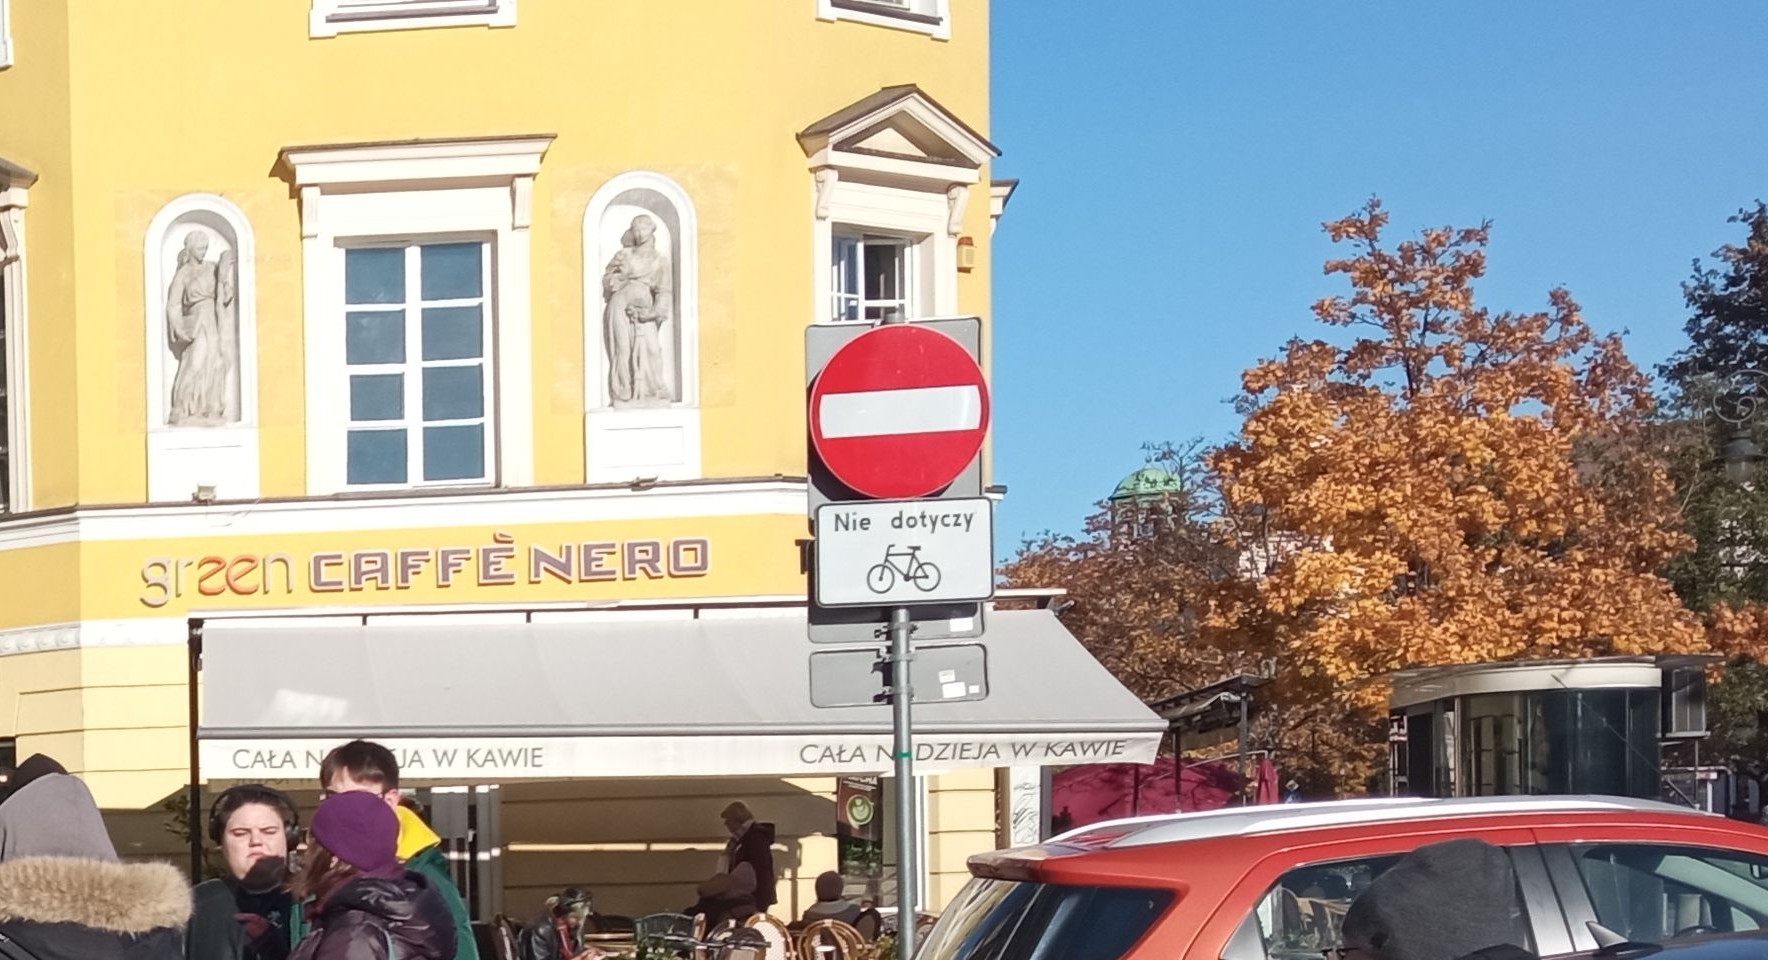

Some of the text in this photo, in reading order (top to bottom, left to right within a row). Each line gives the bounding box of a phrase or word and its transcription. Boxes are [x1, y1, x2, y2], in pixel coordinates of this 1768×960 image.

[834, 509, 975, 534] Nie dotyczy
[139, 553, 294, 608] green
[528, 537, 711, 585] NERO
[232, 748, 297, 769] CAŁA
[432, 749, 458, 768] W
[466, 747, 545, 768] KAWIE
[799, 739, 1128, 764] CAŁA NDZIEJA W KAWIE
